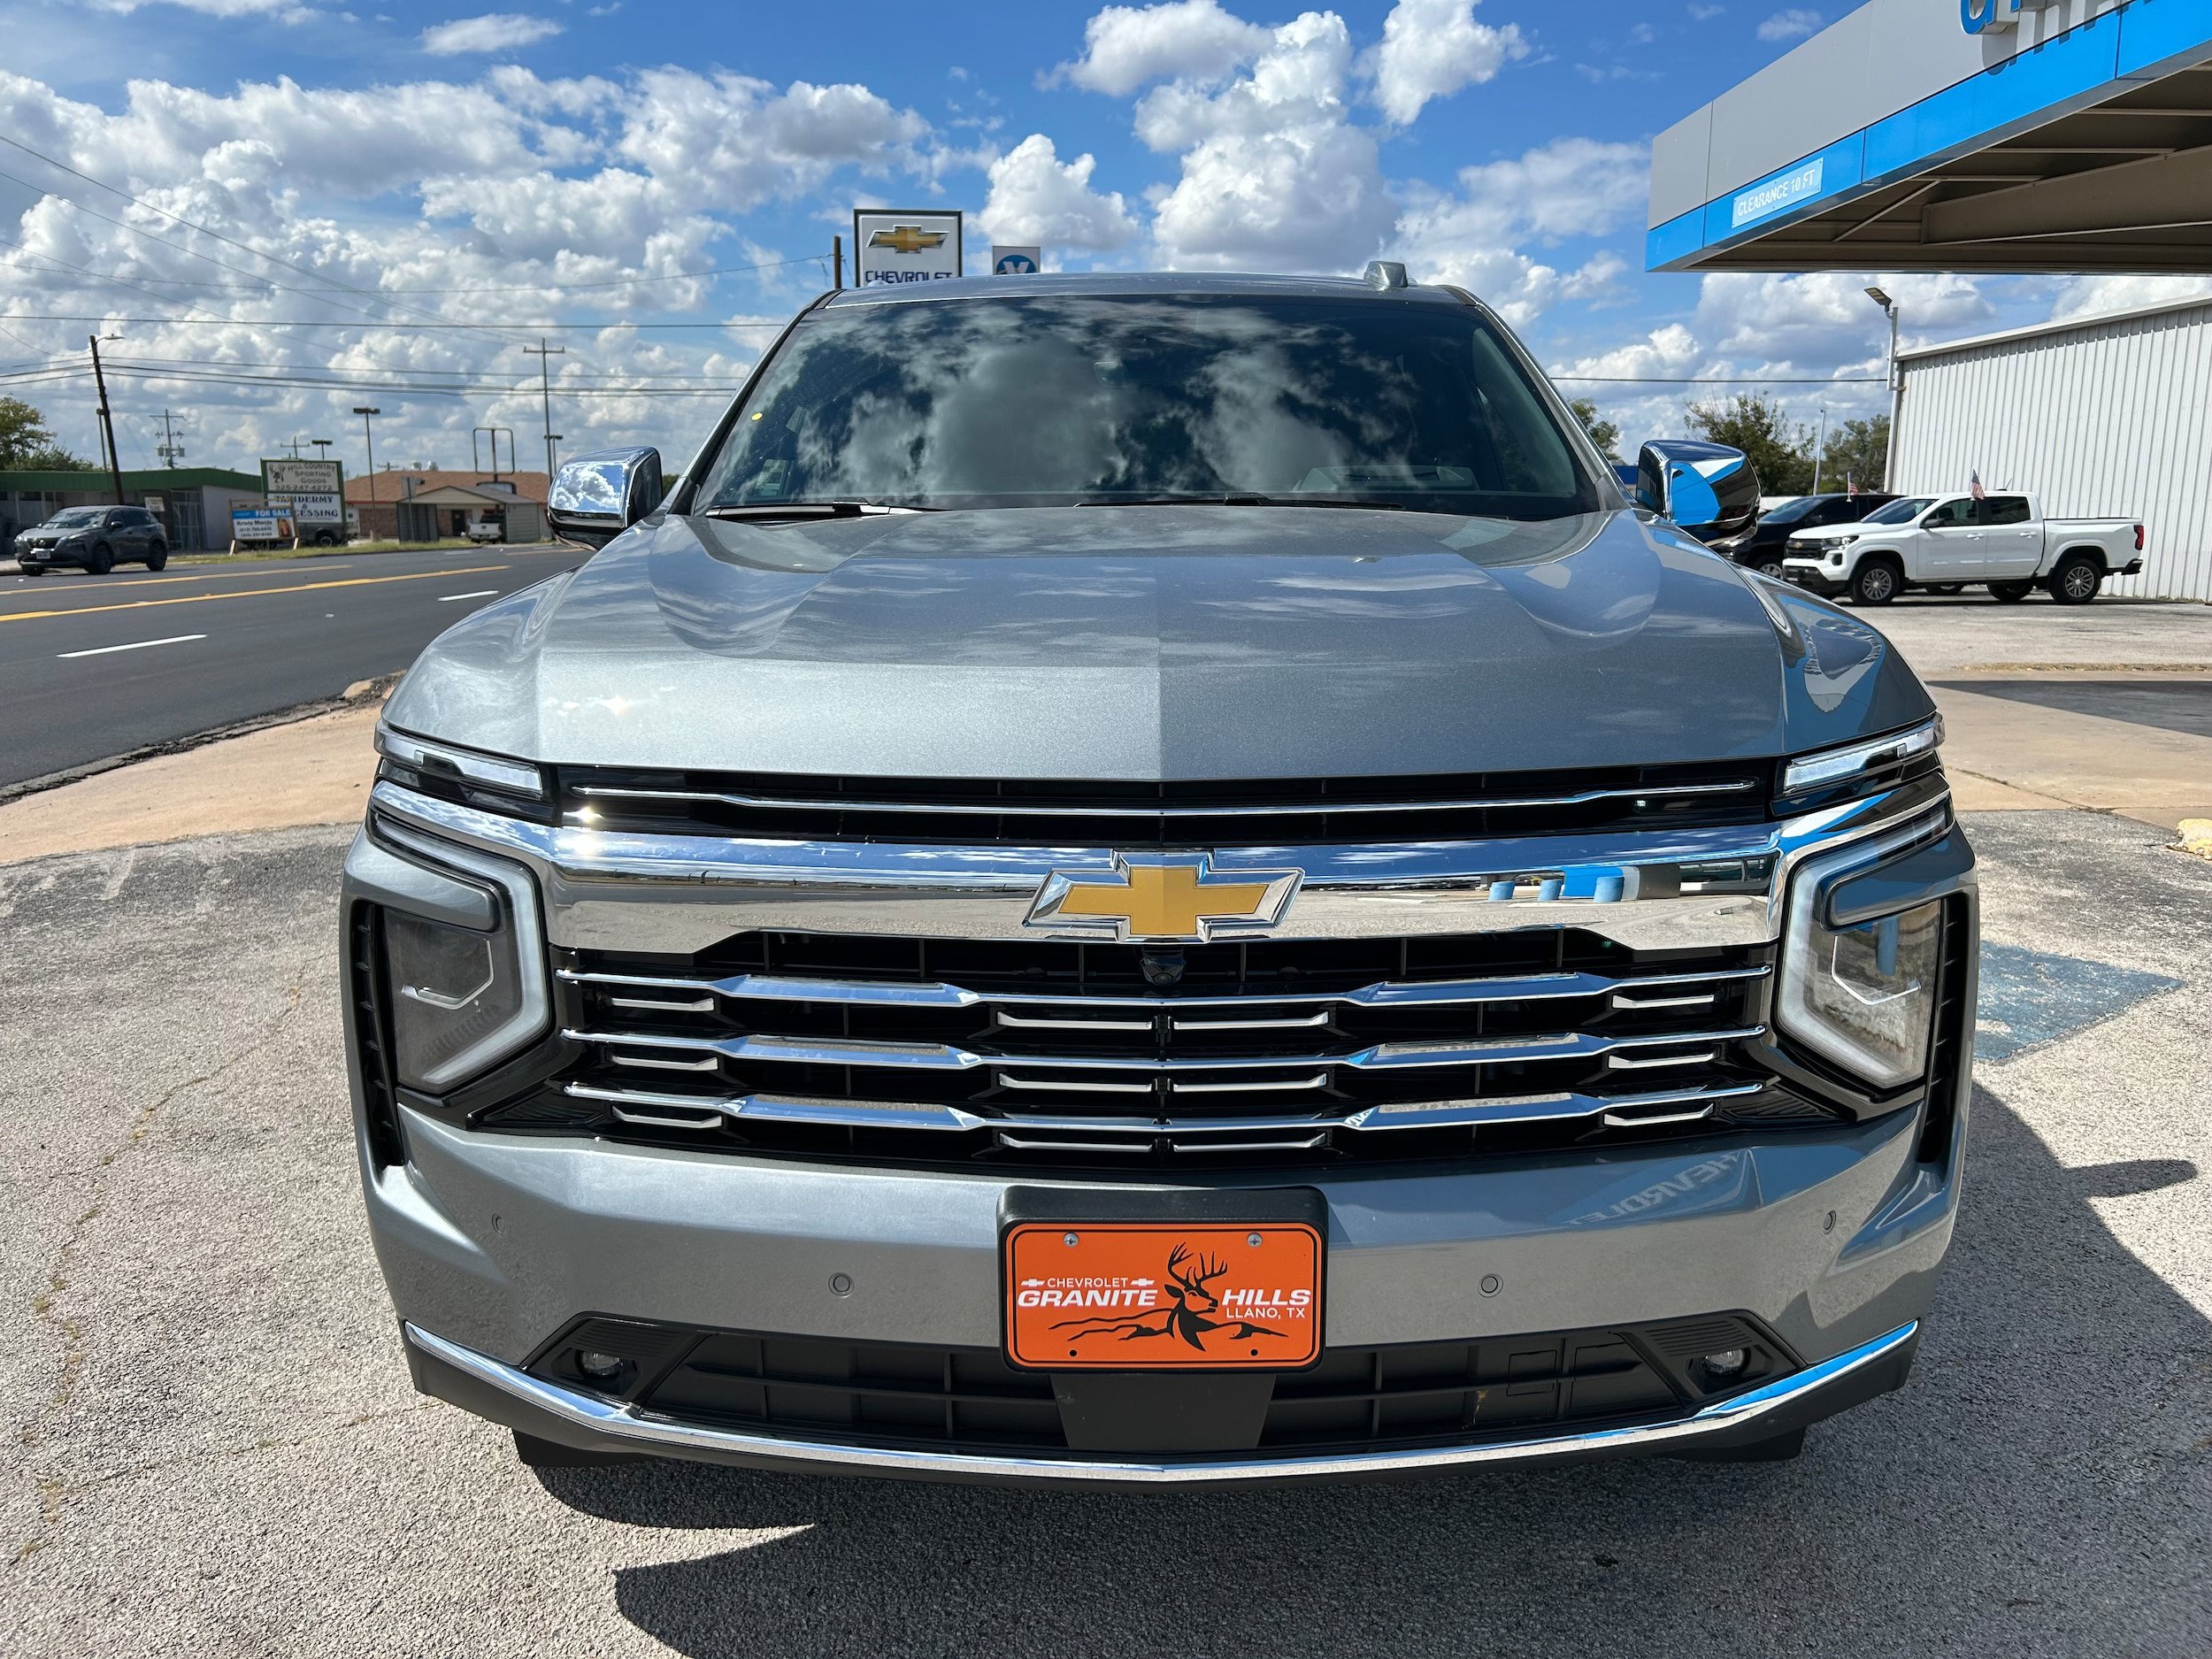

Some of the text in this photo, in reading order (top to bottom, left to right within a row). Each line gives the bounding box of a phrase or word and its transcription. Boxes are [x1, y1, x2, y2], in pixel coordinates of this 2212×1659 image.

[1738, 169, 1816, 217] CLEARANCE 10 FT
[1047, 1278, 1128, 1287] CHEVROLET
[1018, 1288, 1310, 1307] GRANITE HILLS
[1226, 1307, 1305, 1319] LLANO, TX
